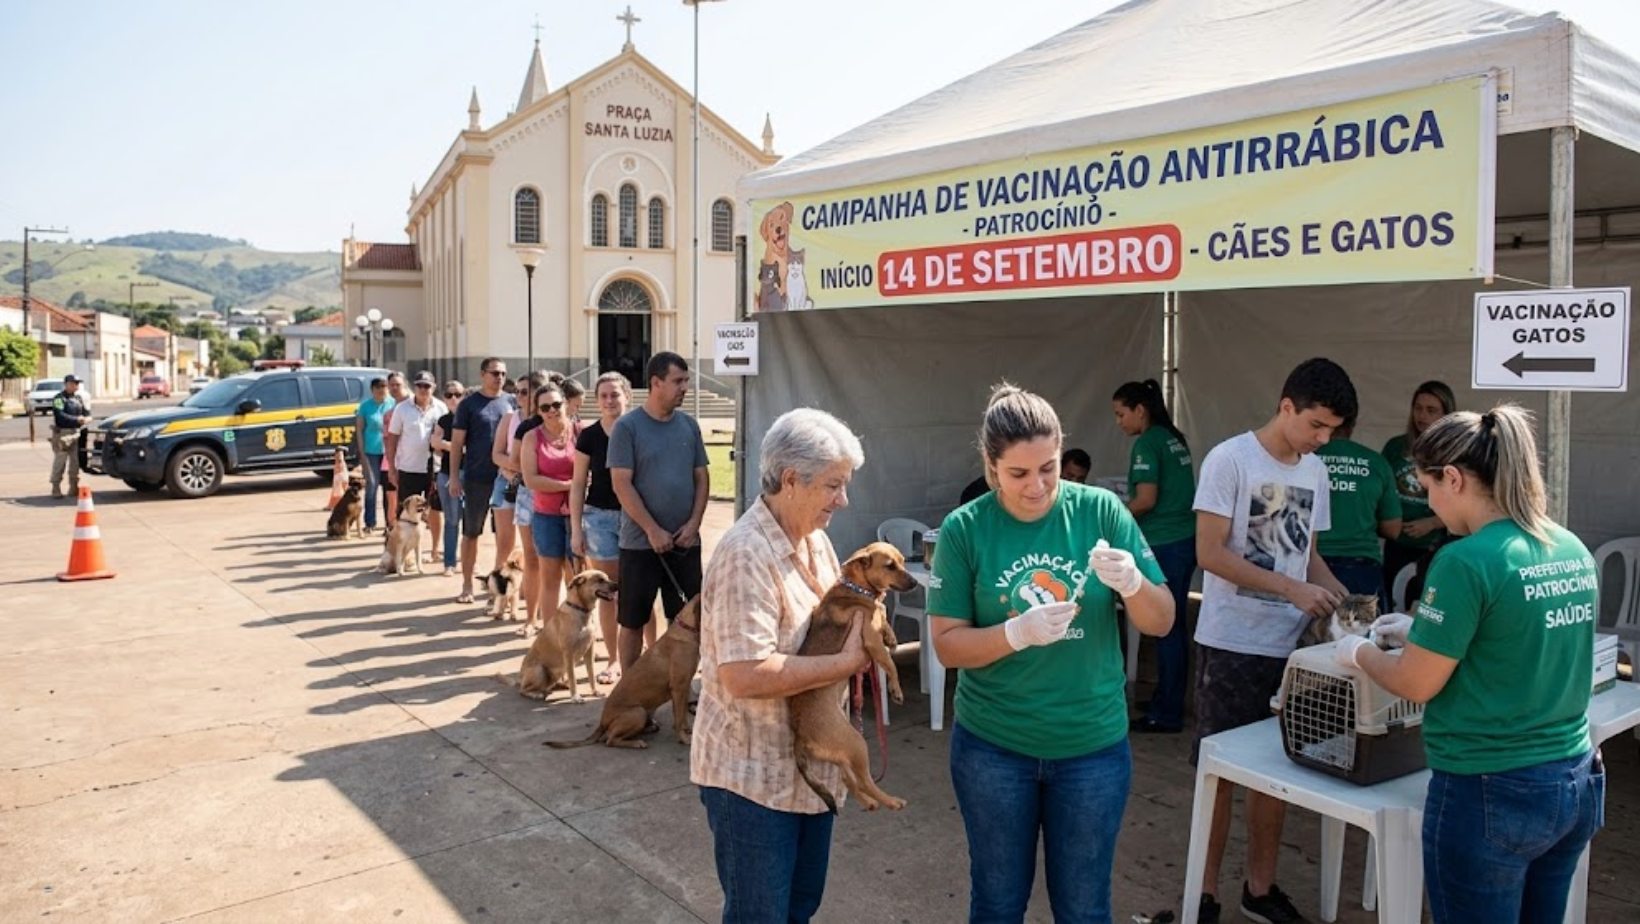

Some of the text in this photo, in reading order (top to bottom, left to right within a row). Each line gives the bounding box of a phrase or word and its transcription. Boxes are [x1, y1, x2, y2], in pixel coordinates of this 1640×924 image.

[605, 104, 652, 123] PRAÇA
[584, 121, 674, 143] SANTA LUZIA
[801, 110, 1445, 231] CAMPANHA DE VACINAÇÃO ANTIRRÁBICA
[974, 202, 1102, 237] PATROCÍNIO
[820, 261, 873, 290] INÍCIO
[882, 256, 917, 291] 14
[924, 252, 965, 288] DE
[971, 233, 1174, 285] SETEMBRO
[1208, 222, 1291, 262] CÃES
[1302, 223, 1322, 256] E
[1330, 211, 1455, 253] GATOS
[1486, 298, 1616, 322] VACINAÇÃO
[1512, 327, 1586, 343] GATOS
[316, 426, 356, 446] PRF
[1327, 464, 1370, 477] OCÍNIO
[1329, 478, 1357, 492] ÚDE
[995, 553, 1085, 588] VACINAÇÃO
[1519, 559, 1584, 581] PREFEITURA
[1545, 601, 1593, 629] SAÚDE
